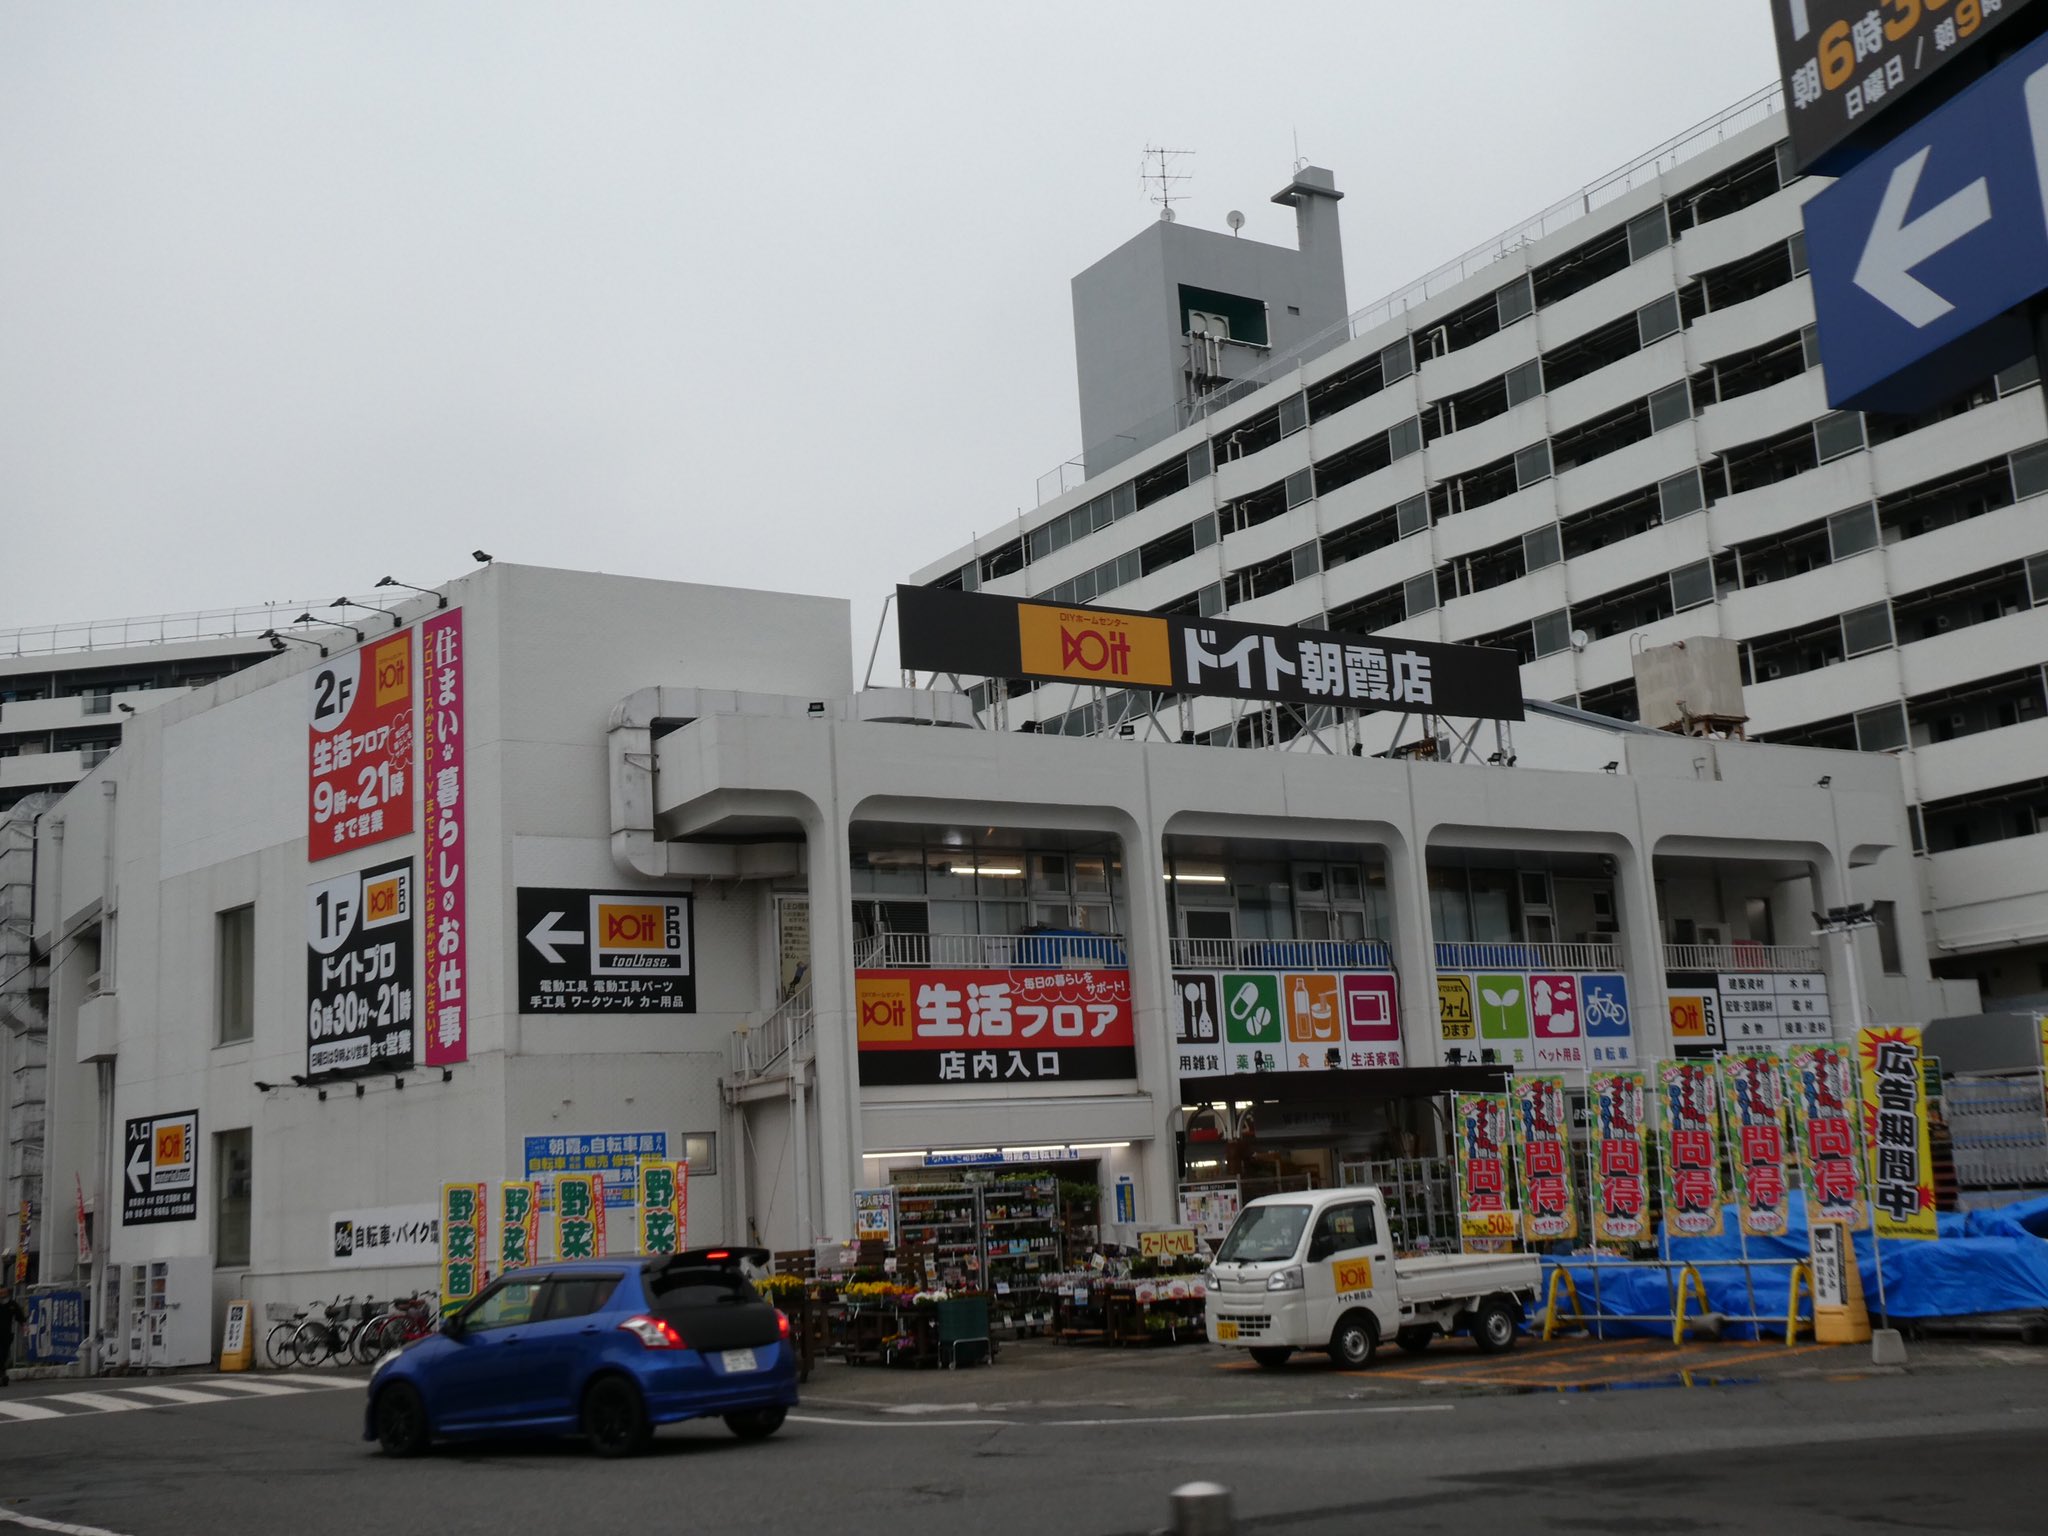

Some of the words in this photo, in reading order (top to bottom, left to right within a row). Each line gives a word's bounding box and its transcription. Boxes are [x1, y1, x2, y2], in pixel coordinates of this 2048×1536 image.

[1845, 54, 1905, 119] 日曜日
[1059, 612, 1129, 627] DIYホームセンター
[314, 669, 353, 721] 2F
[313, 724, 390, 778] 生活フロア
[333, 809, 384, 844] まで営業
[316, 890, 350, 940] 1F
[398, 876, 406, 914] PRO
[665, 905, 681, 949] PRO
[321, 942, 396, 992] ドイトプロ
[540, 980, 588, 993] 電動工具
[593, 980, 673, 993] 電動工具パーツ
[1023, 972, 1093, 991] 毎日の暮らしを
[530, 996, 566, 1009] 手工具
[571, 996, 634, 1008] ワークツール
[639, 995, 684, 1008] カー用品
[916, 983, 1119, 1038] 生活フロア
[1703, 996, 1717, 1036] PRO
[370, 1029, 412, 1057] まで営業
[939, 1051, 1060, 1080] 店内入口
[1351, 1051, 1401, 1067] 生活家電
[1538, 1048, 1582, 1062] ペット用品
[1594, 1047, 1629, 1061] 自転車
[129, 1121, 150, 1141] 入口
[1873, 1039, 1920, 1223] 広告期間中
[1525, 1141, 1567, 1215] 問得
[1601, 1138, 1643, 1214] 問得
[1671, 1129, 1716, 1209] 問得
[1741, 1125, 1784, 1207] 問得
[1807, 1118, 1859, 1202] 問得
[643, 1168, 676, 1254] 野菜
[447, 1187, 476, 1299] 野菜苗
